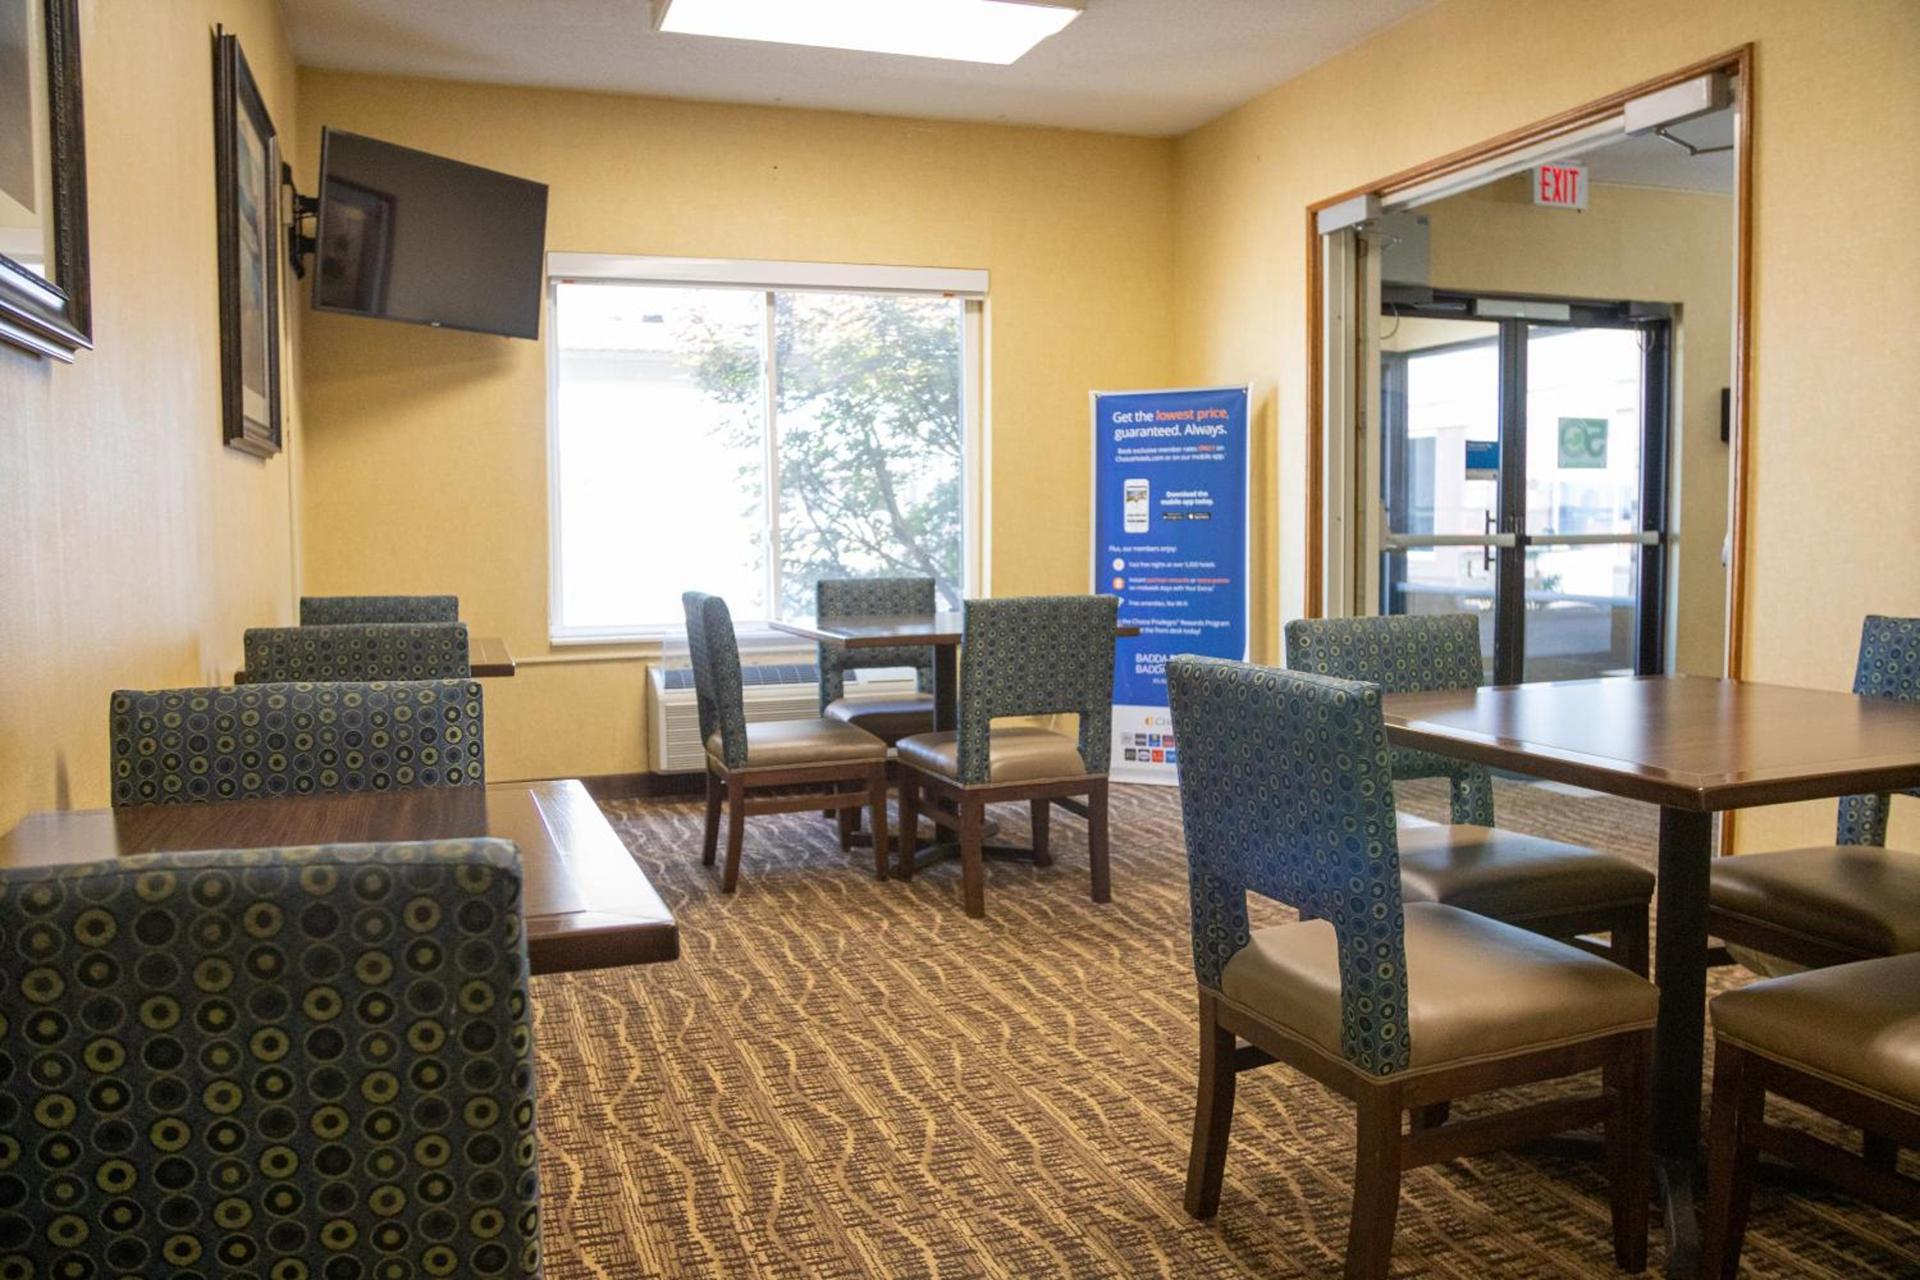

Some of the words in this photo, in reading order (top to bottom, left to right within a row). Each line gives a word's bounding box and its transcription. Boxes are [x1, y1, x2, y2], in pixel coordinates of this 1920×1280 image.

[1541, 166, 1579, 205] EXIT
[1112, 411, 1133, 423] Get
[1134, 410, 1154, 422] the
[1155, 409, 1193, 421] lowest
[1114, 424, 1181, 441] guaranteed.
[1184, 423, 1227, 437] Always.
